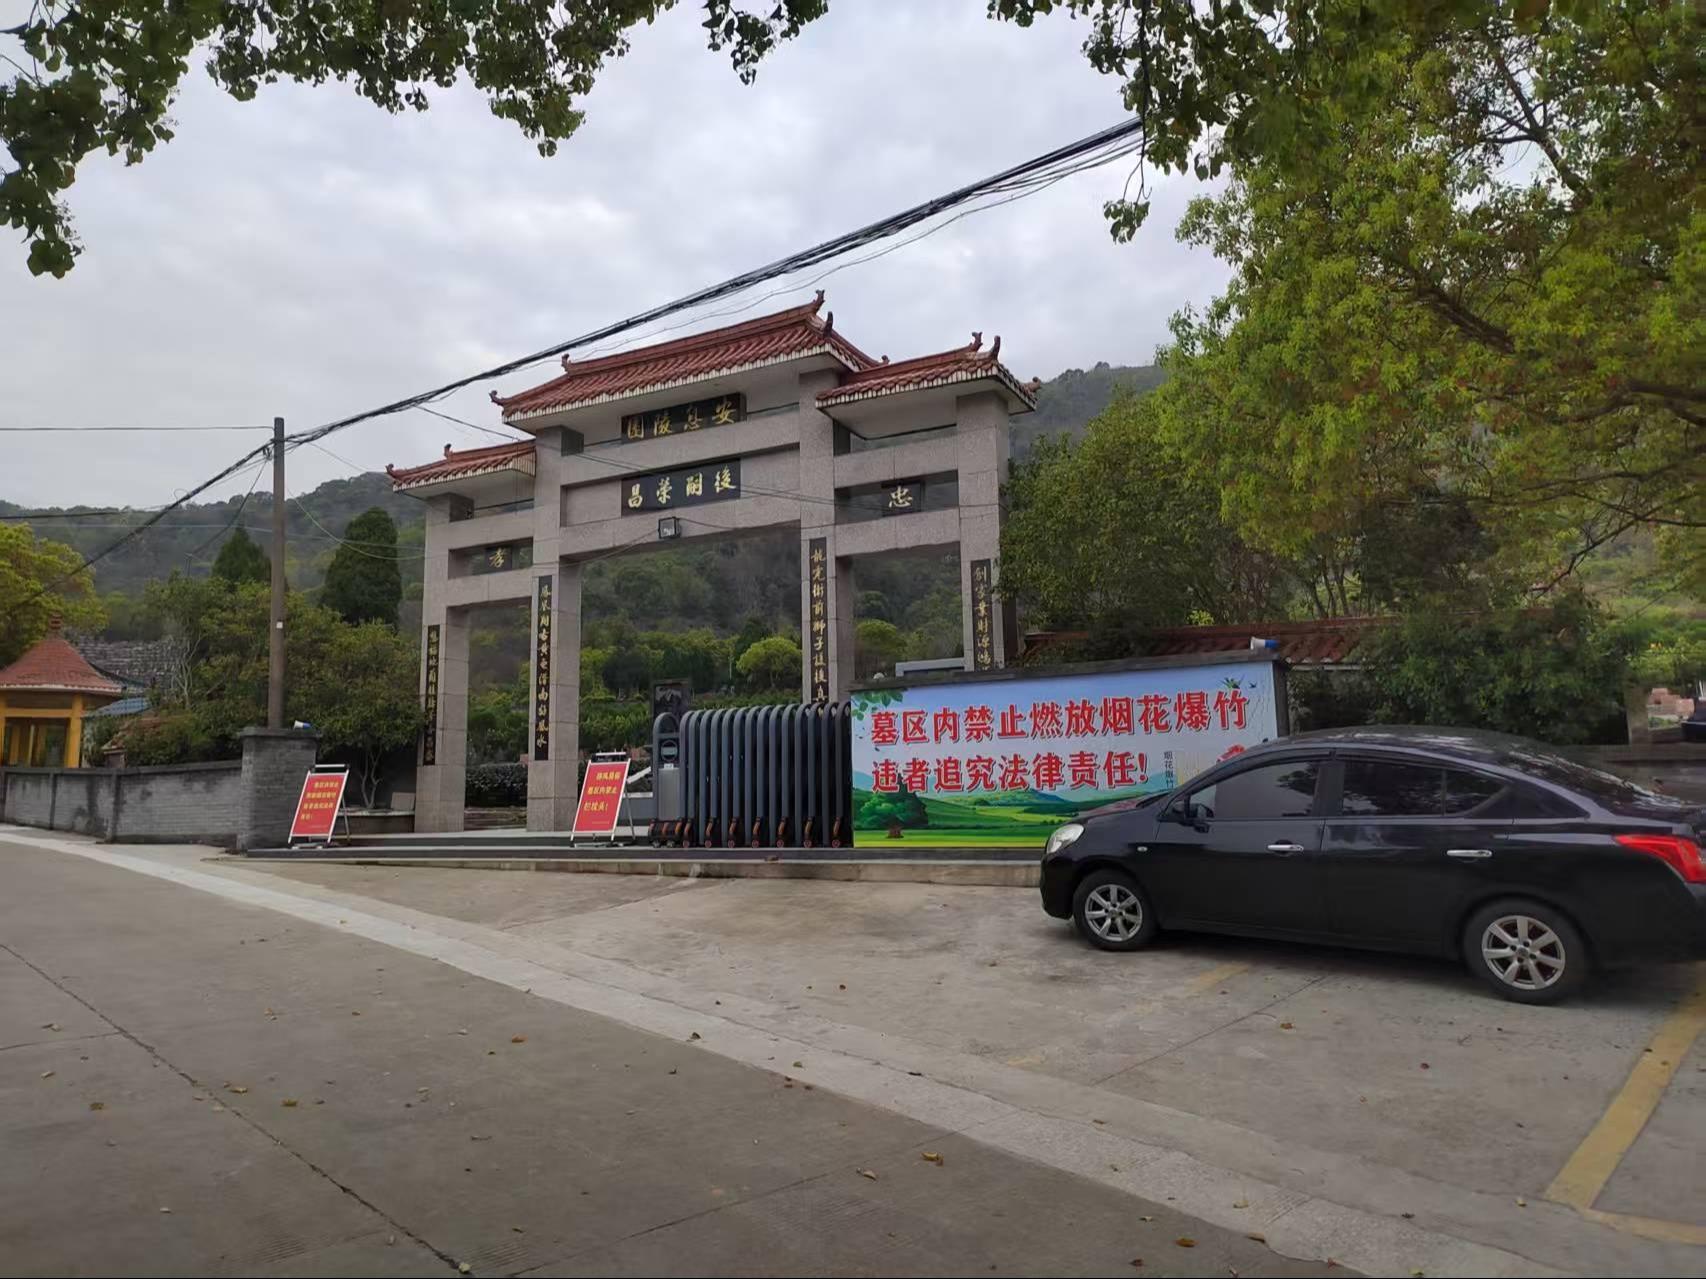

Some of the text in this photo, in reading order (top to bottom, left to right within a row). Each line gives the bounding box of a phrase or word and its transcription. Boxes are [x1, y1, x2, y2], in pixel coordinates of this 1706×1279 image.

[888, 486, 914, 510] 忠
[871, 690, 1249, 745] 墓区内禁止燃放烟花爆竹
[871, 750, 1149, 793] 违者追究法律责任!
